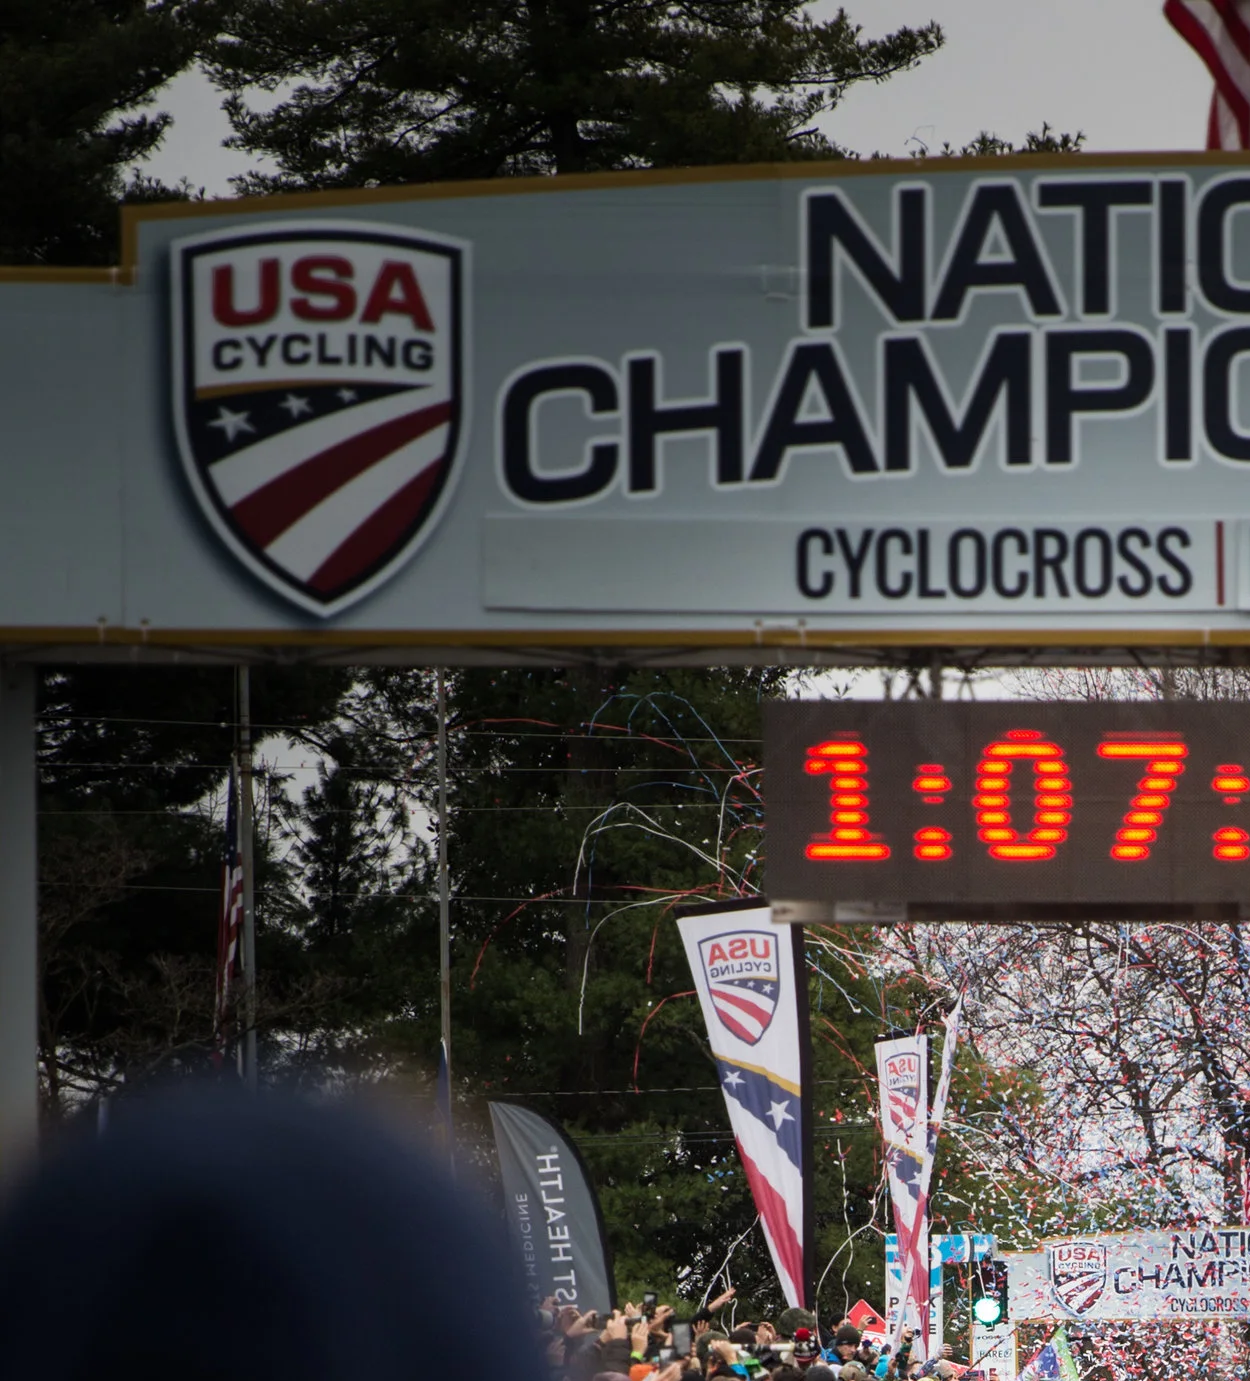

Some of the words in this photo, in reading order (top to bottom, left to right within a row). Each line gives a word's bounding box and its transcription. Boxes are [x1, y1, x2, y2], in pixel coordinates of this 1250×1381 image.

[212, 255, 435, 333] USA
[212, 333, 434, 374] CYCLING
[796, 527, 1193, 600] CYCLOCROSS
[1058, 1246, 1101, 1262] USA
[1171, 1297, 1248, 1313] CYCLOCROSS
